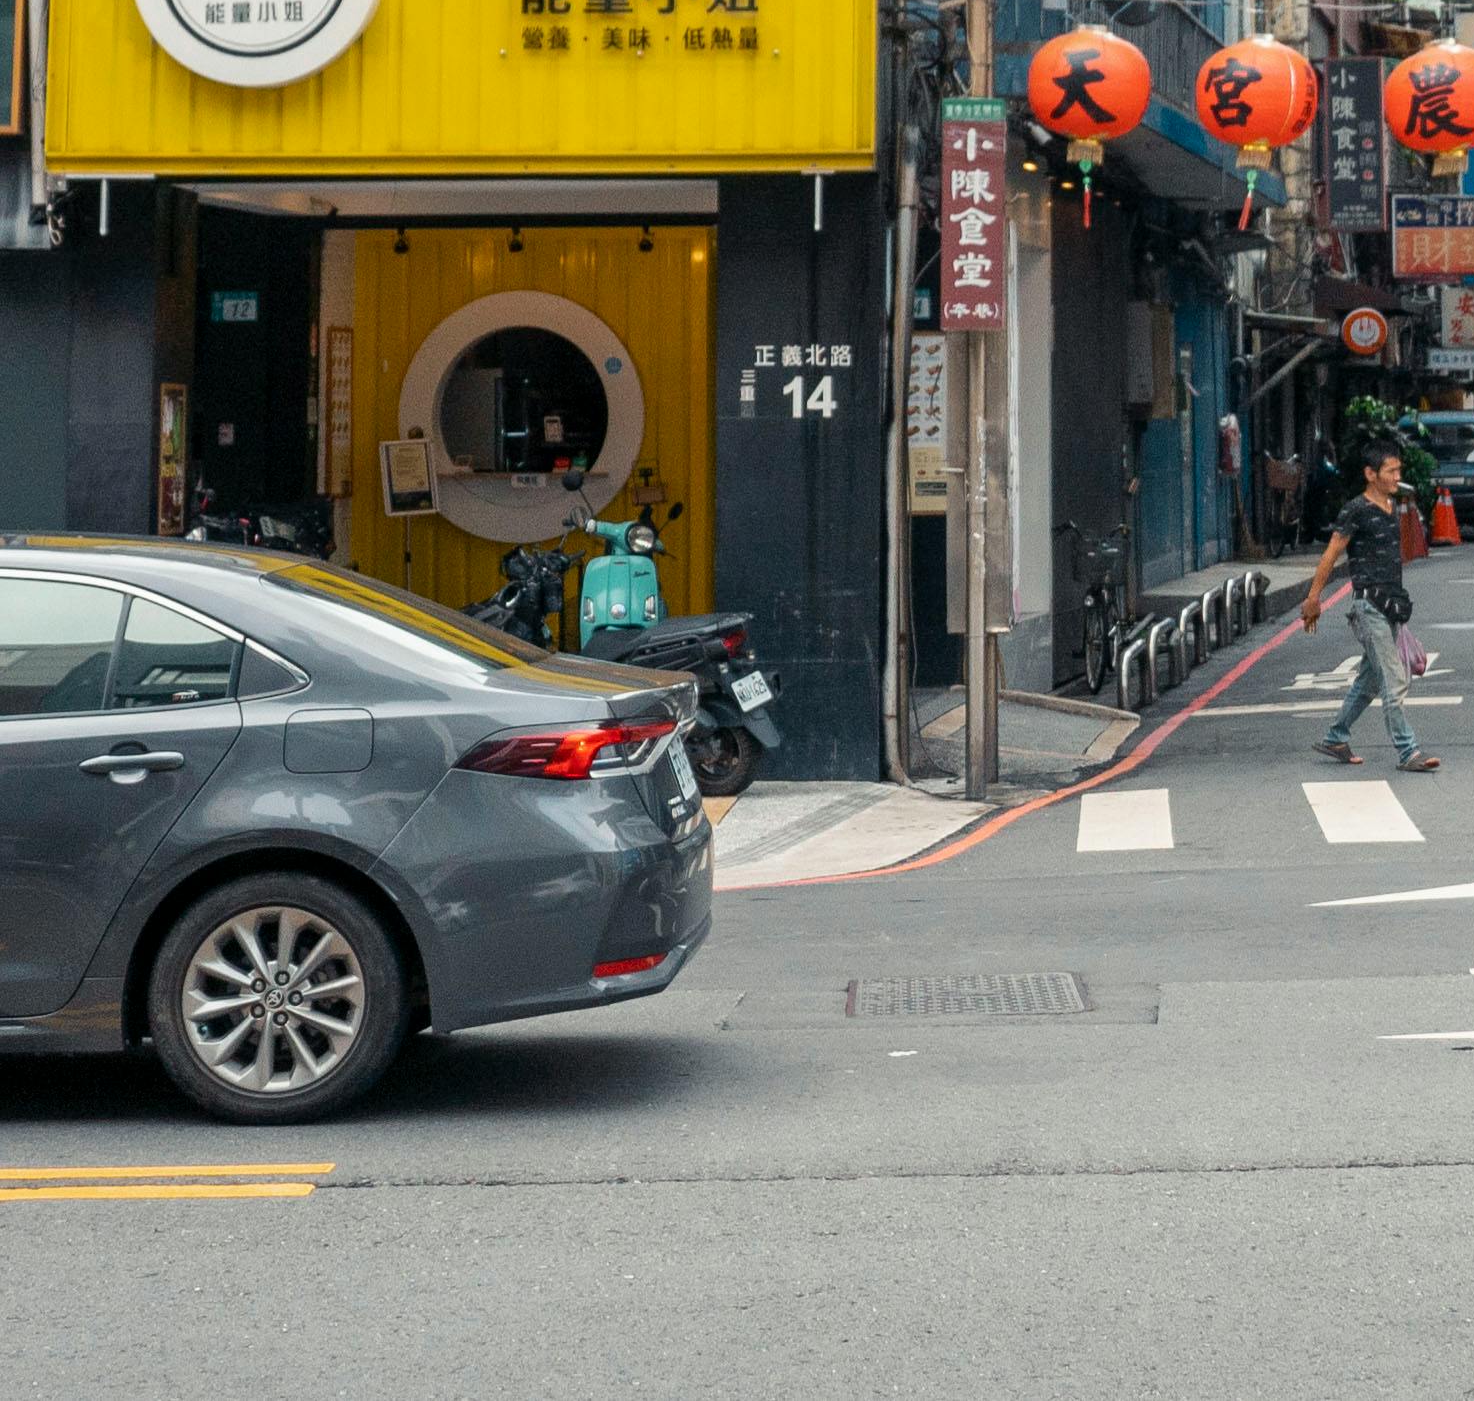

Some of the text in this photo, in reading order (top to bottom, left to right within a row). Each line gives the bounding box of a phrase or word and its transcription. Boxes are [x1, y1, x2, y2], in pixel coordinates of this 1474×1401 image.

[204, 0, 305, 24] 能量小姐
[1051, 48, 1117, 124] 天
[1205, 57, 1262, 128] 宮
[1404, 64, 1474, 139] 農
[1331, 66, 1357, 182] 小陳食堂
[949, 127, 997, 288] 小陳食堂
[754, 344, 852, 366] 正義北路
[783, 375, 838, 418] 14
